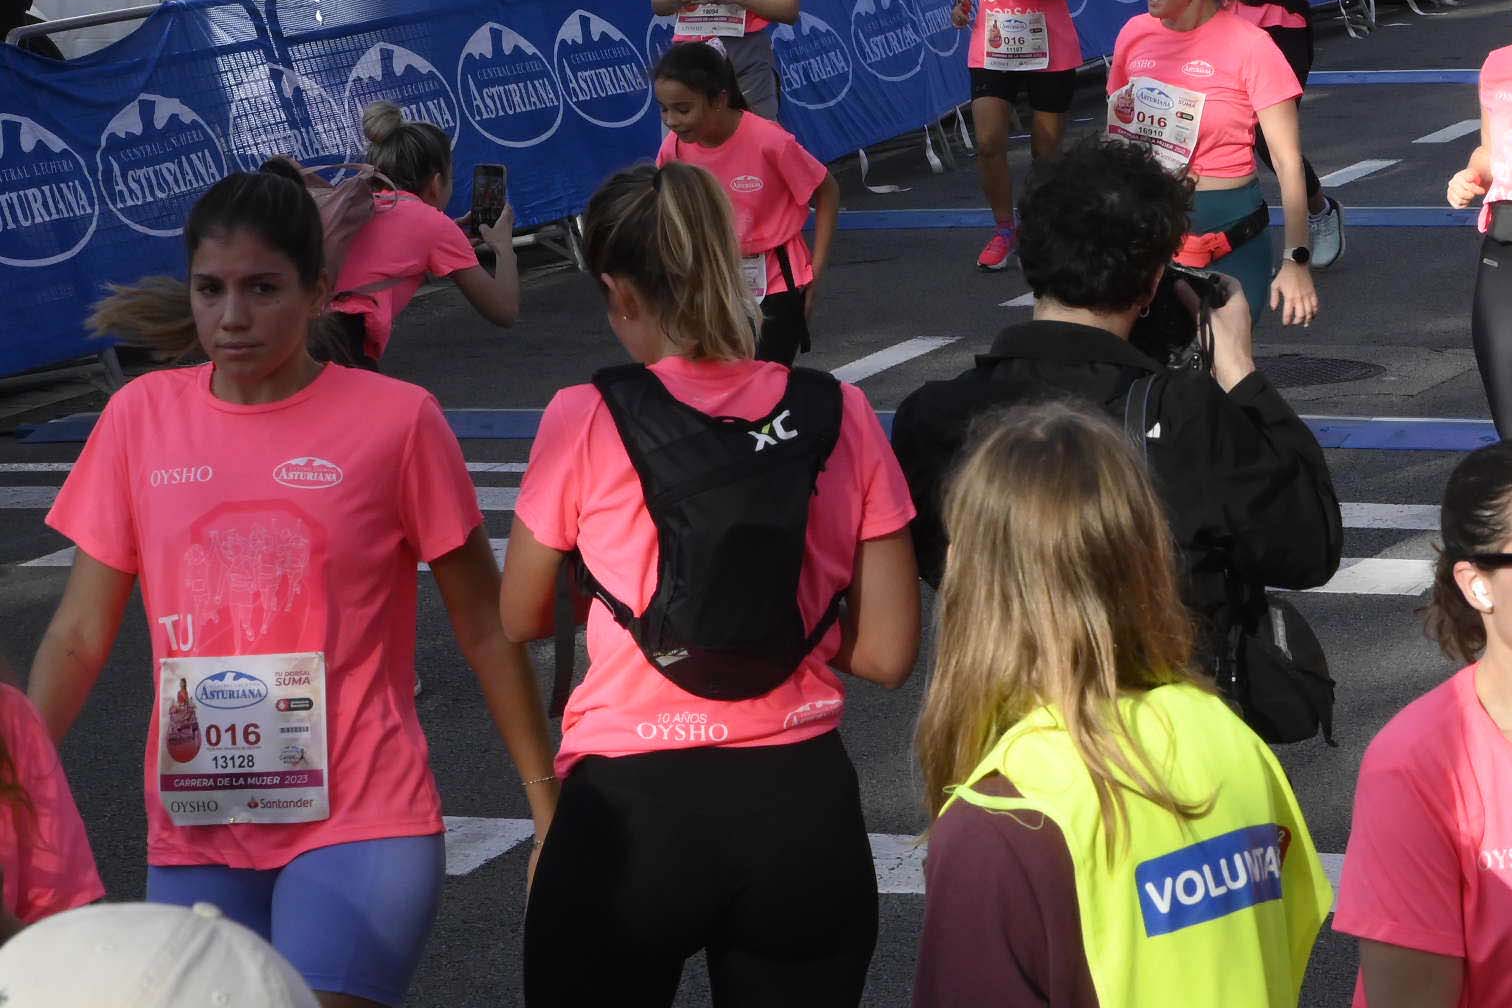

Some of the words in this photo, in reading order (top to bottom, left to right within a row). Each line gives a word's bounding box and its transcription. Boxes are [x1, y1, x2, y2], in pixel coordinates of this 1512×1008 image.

[1003, 36, 1025, 45] 016
[562, 57, 648, 103] ASTURIANA
[467, 74, 560, 121] ASTURIANA
[1136, 111, 1167, 128] 016
[0, 179, 94, 231] TURIANA
[150, 465, 213, 487] OYSHO
[279, 469, 337, 482] ASTURIANA
[159, 614, 195, 652] TU
[275, 676, 312, 687] SUMA
[200, 688, 263, 700] ASTURIANA
[205, 723, 262, 746] 016
[636, 722, 729, 742] OYSHO
[212, 754, 255, 769] 13128
[174, 777, 215, 787] CARRERA
[217, 777, 230, 786] DE
[232, 776, 245, 785] LA
[247, 776, 280, 785] MUJER
[284, 774, 308, 784] 2023
[170, 800, 219, 813] OYSHO
[259, 797, 314, 810] Santander
